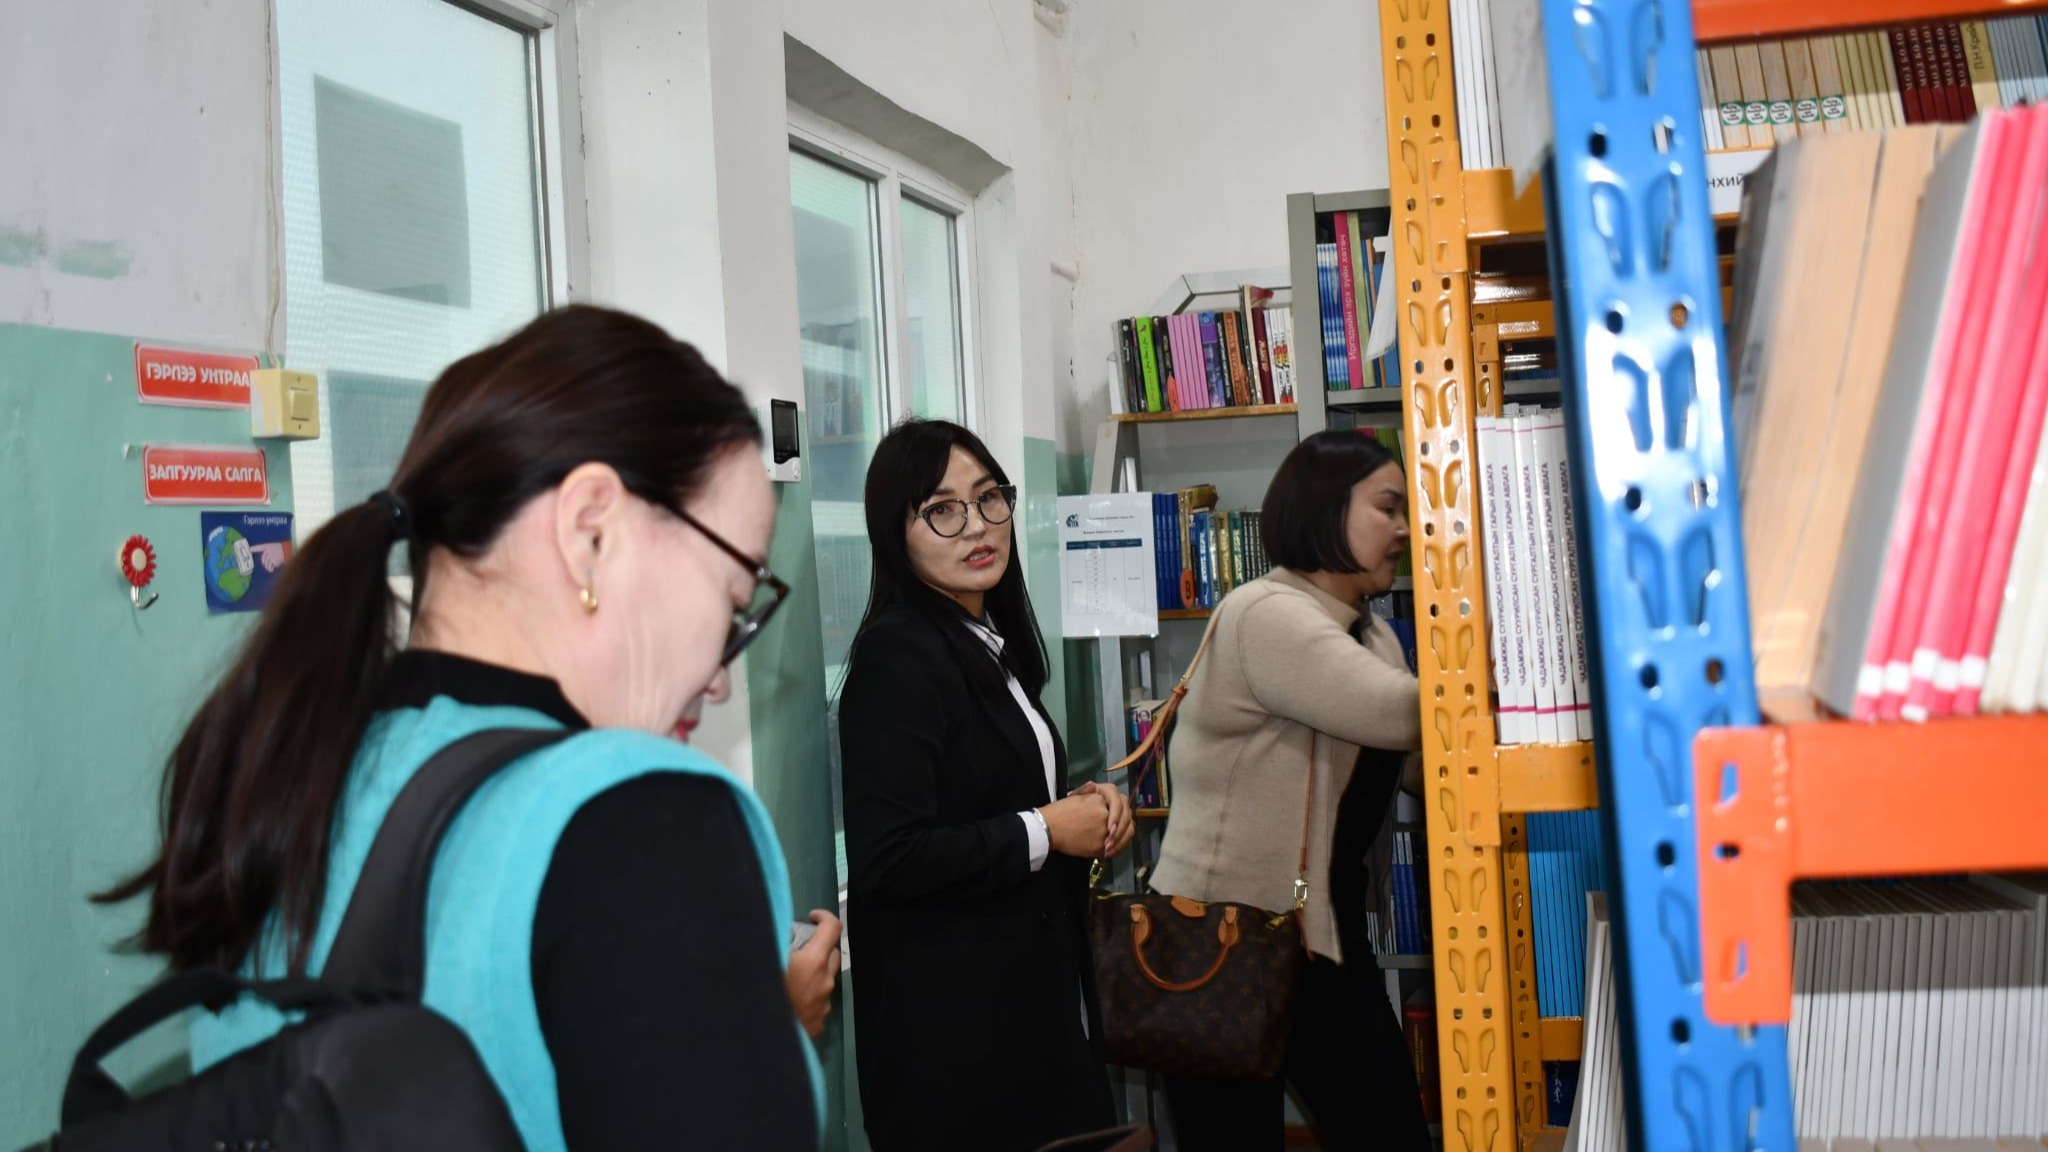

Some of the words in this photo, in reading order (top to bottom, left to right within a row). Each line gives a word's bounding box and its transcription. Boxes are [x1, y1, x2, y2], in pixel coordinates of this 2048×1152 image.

[146, 362, 197, 382] ГЭРЛЭЭ
[201, 367, 250, 387] УНТРАА
[149, 464, 222, 481] ЗАЛГУУРАА
[225, 466, 262, 482] САЛГА
[1502, 465, 1511, 498] АВЛАГА
[1541, 462, 1551, 496] АВЛАГА
[1504, 500, 1514, 529] ГАРЫН
[1544, 498, 1554, 527] ГАРЫН
[1507, 532, 1518, 582] СУРГАЛТЫН
[1547, 530, 1558, 581] СУРГАЛТЫН
[1511, 584, 1522, 634] СУУРИЛСАН
[1551, 582, 1562, 633] СУУРИЛСАН
[1516, 636, 1527, 685] ЧАДАМЖИД
[1555, 635, 1566, 684] ЧАДАМЖИД
